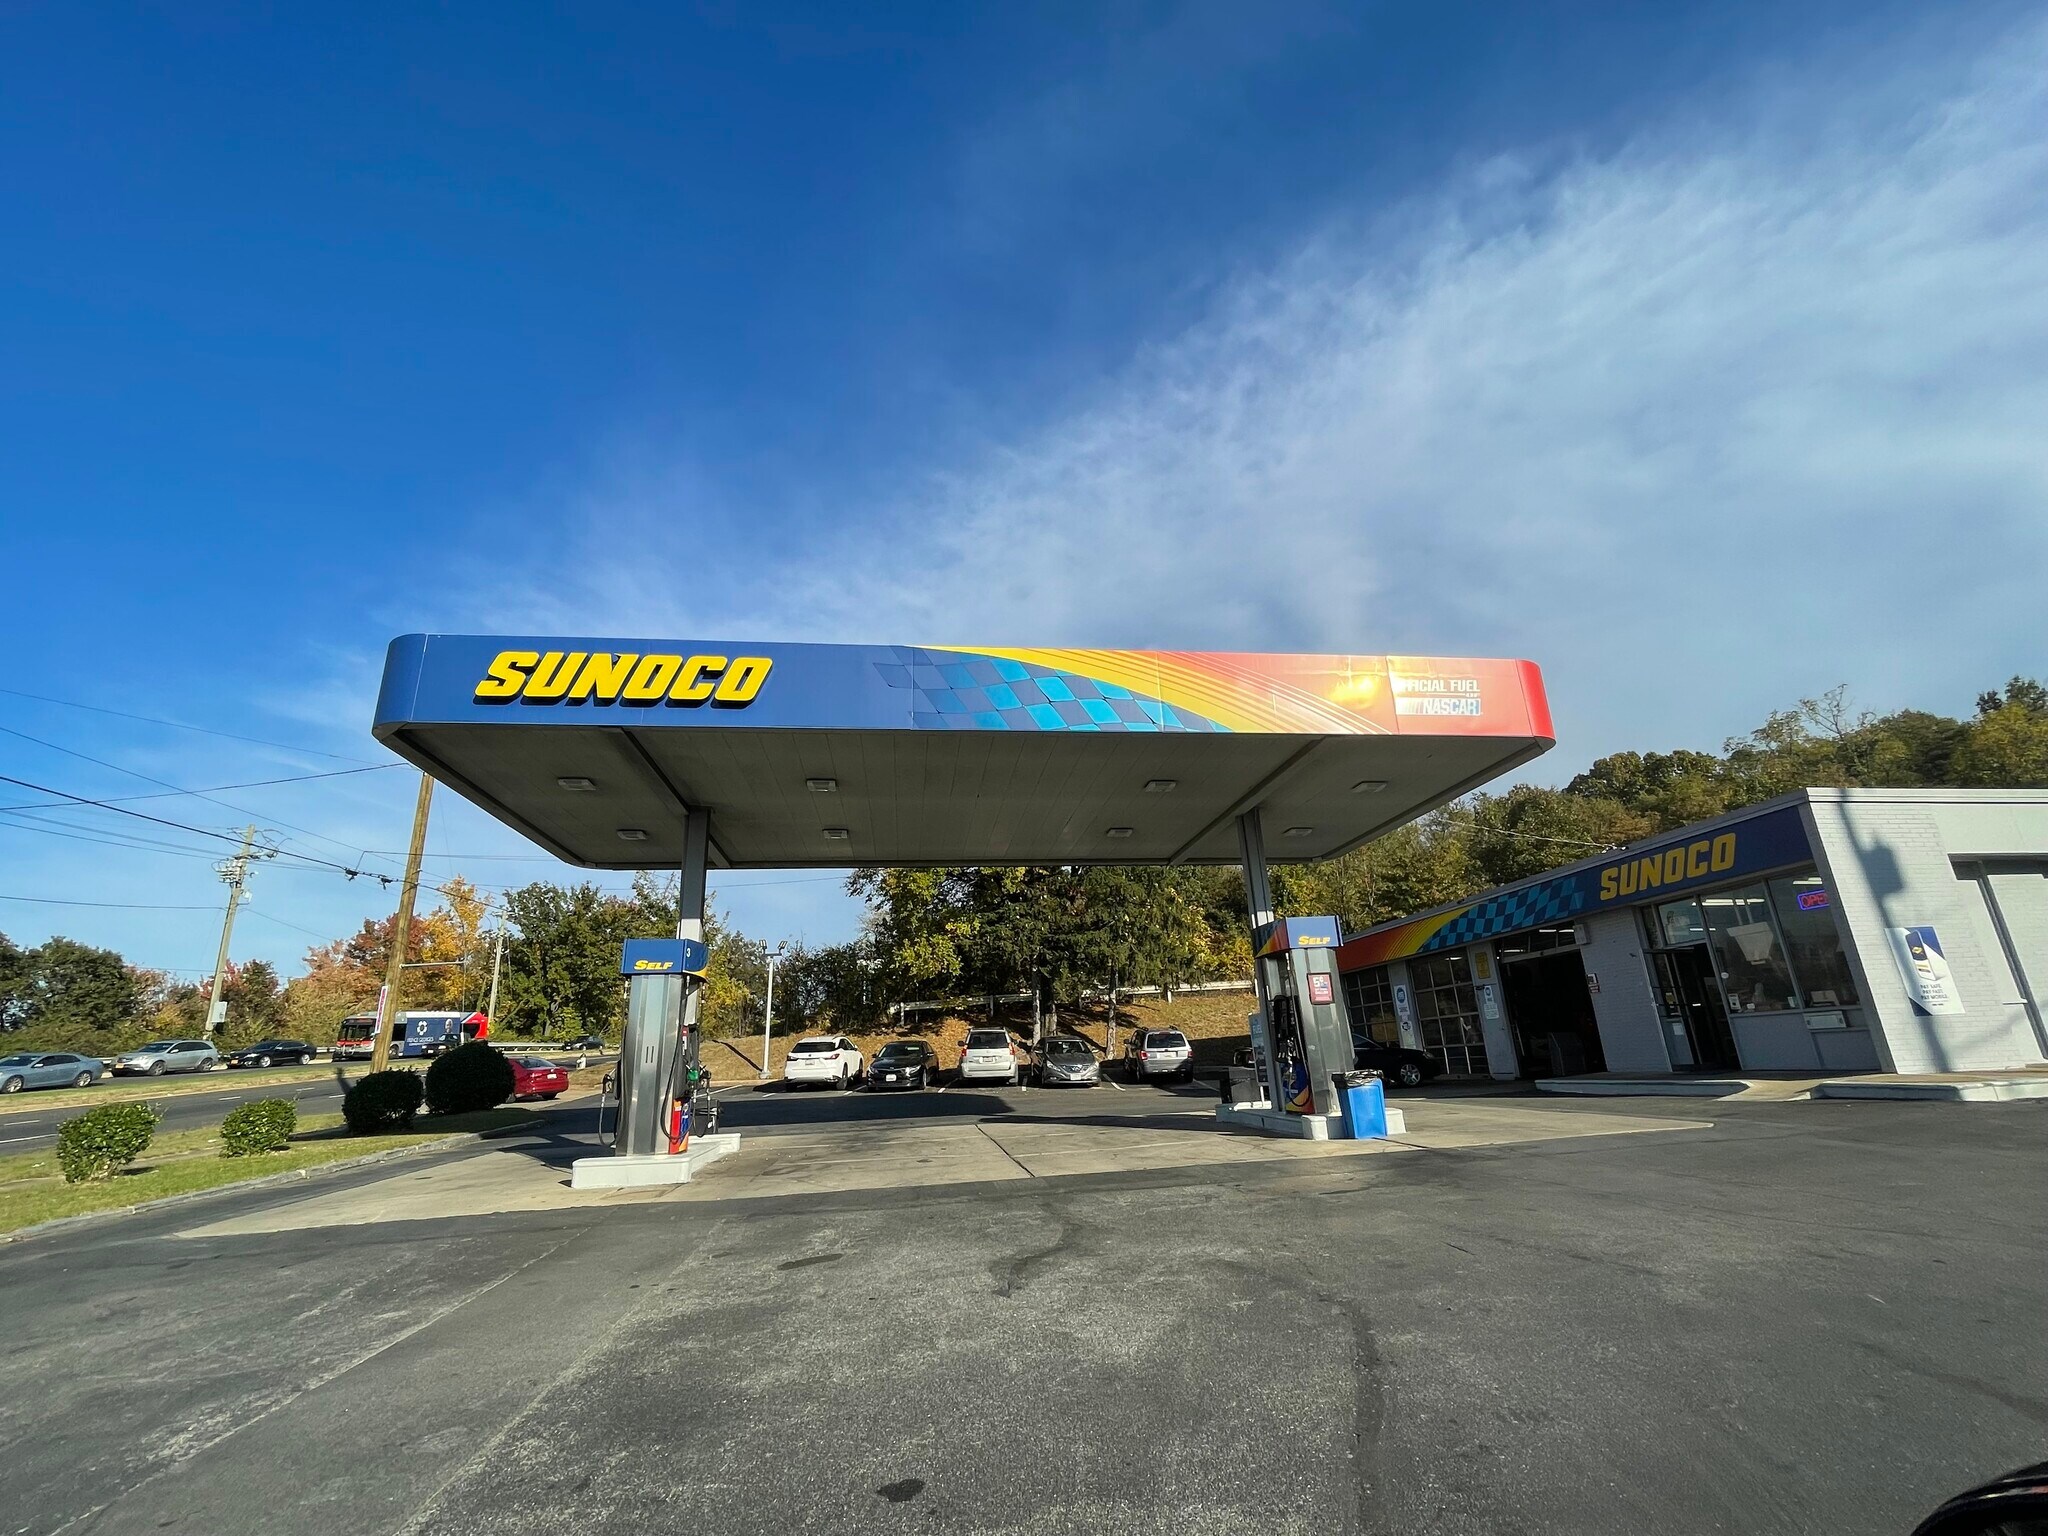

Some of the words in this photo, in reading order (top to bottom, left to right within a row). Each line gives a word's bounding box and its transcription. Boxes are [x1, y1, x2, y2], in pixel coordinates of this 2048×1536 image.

[474, 651, 774, 704] SUNOCO
[1449, 679, 1481, 692] FUEL
[1422, 699, 1479, 714] NASCAR
[1600, 832, 1736, 901] SUNOCO
[1298, 935, 1331, 945] SELF
[686, 947, 691, 958] 3
[633, 959, 674, 970] SELF
